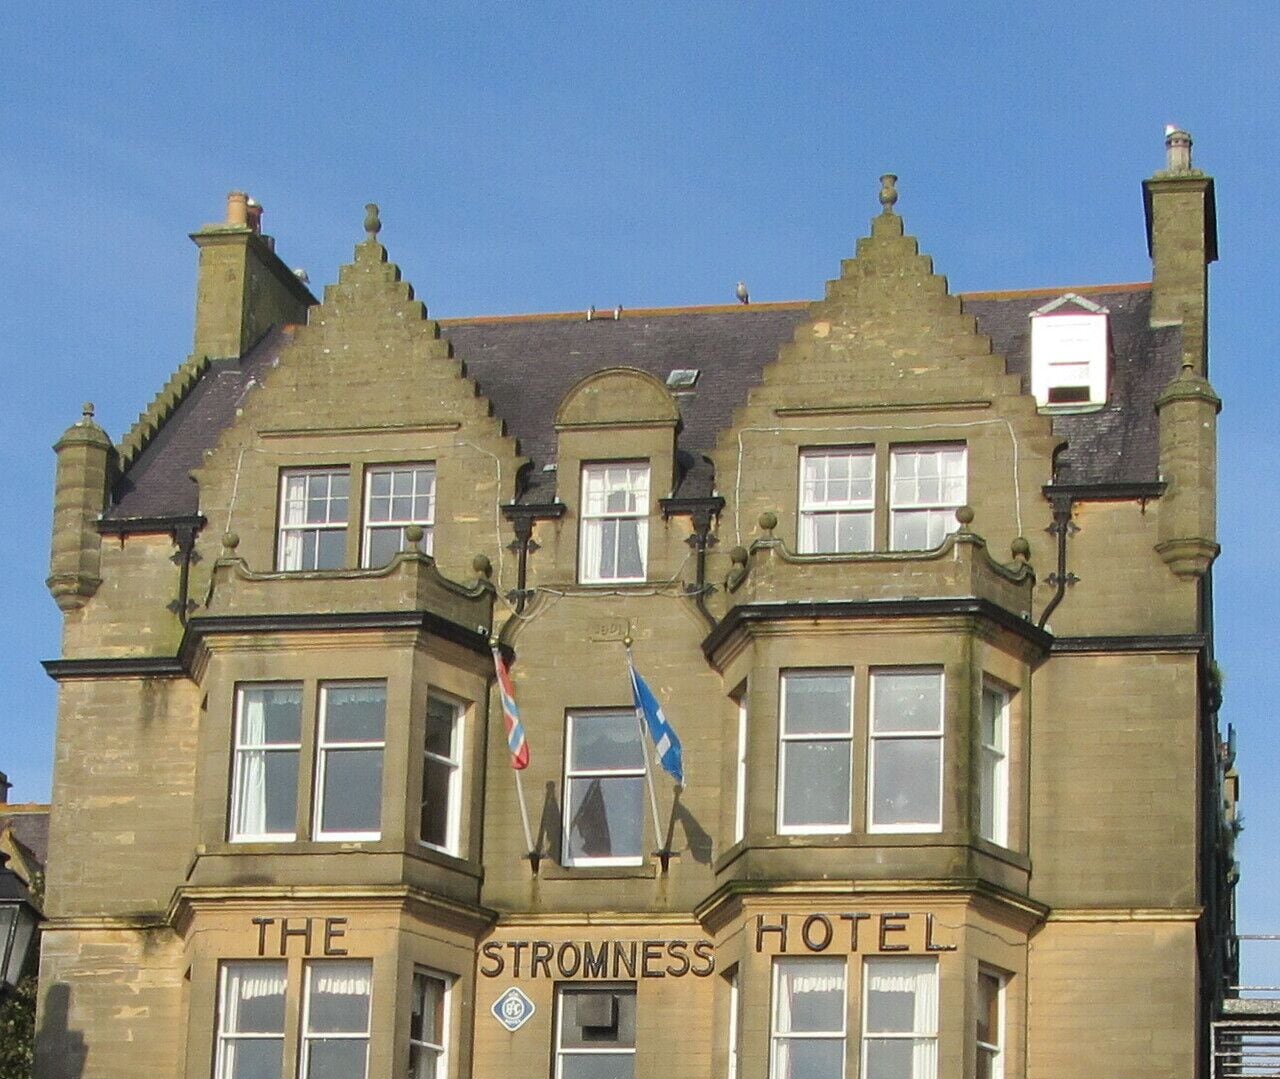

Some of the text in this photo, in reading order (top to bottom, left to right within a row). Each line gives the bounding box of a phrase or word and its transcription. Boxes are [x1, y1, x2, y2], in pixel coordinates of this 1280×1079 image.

[252, 912, 958, 979] THE STROMNESS HOTEL
